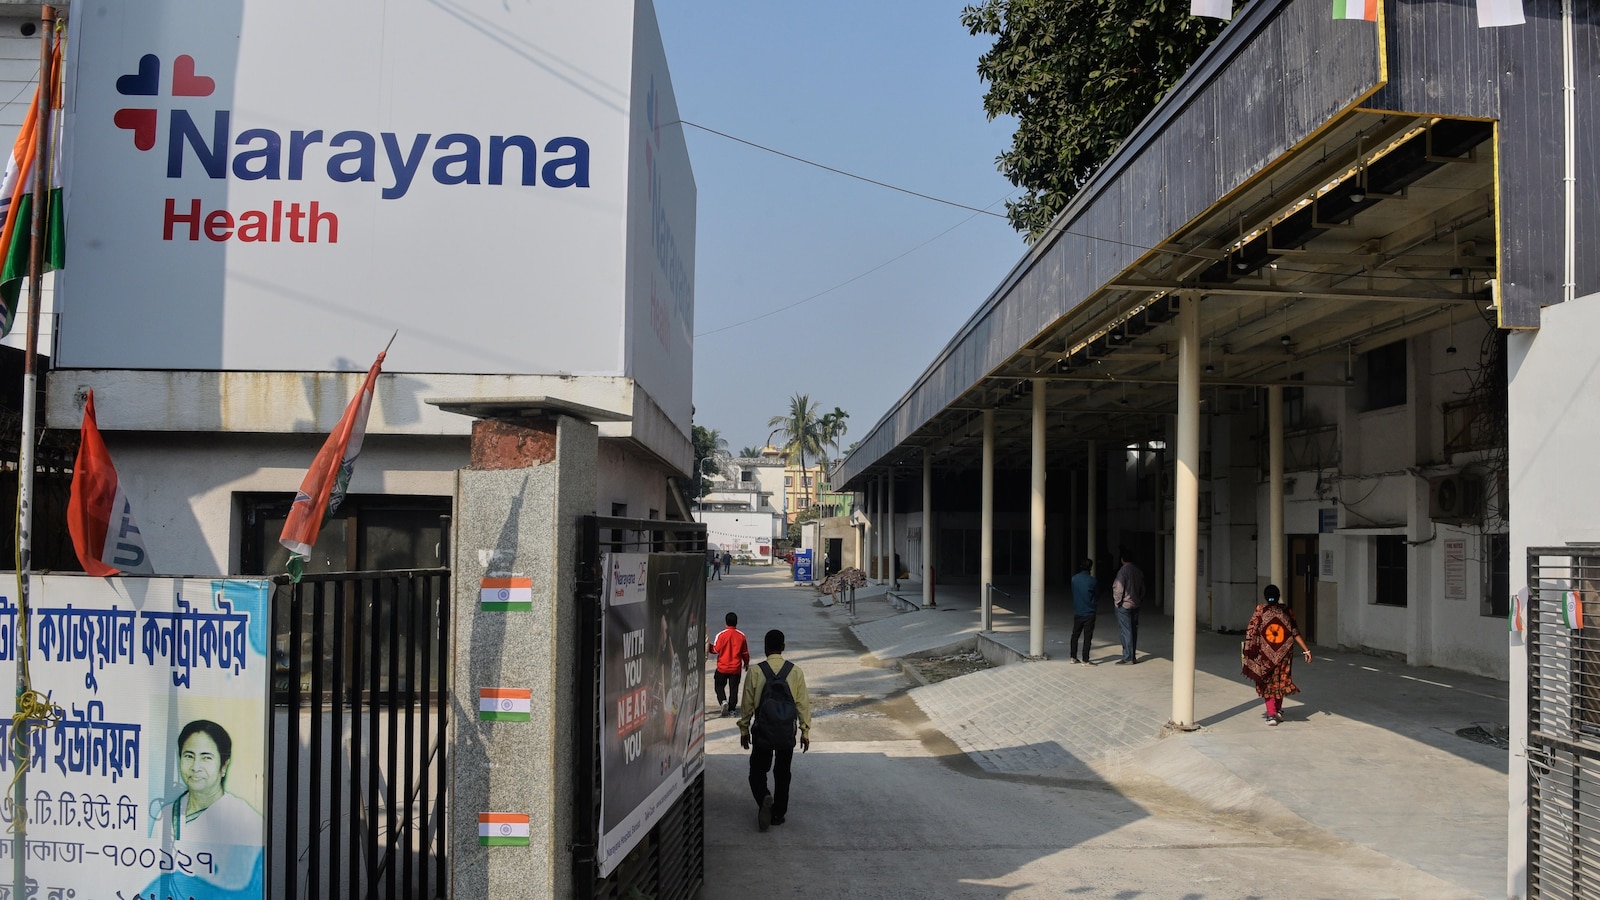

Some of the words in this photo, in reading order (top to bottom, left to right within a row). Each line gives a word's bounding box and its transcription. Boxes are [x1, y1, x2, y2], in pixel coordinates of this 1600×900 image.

[166, 109, 590, 200] Narayana
[162, 198, 339, 244] Health
[615, 571, 636, 588] Narayana
[623, 628, 645, 660] WITH
[624, 658, 642, 688] YOU
[617, 690, 647, 729] NEAR
[624, 730, 642, 765] YOU
